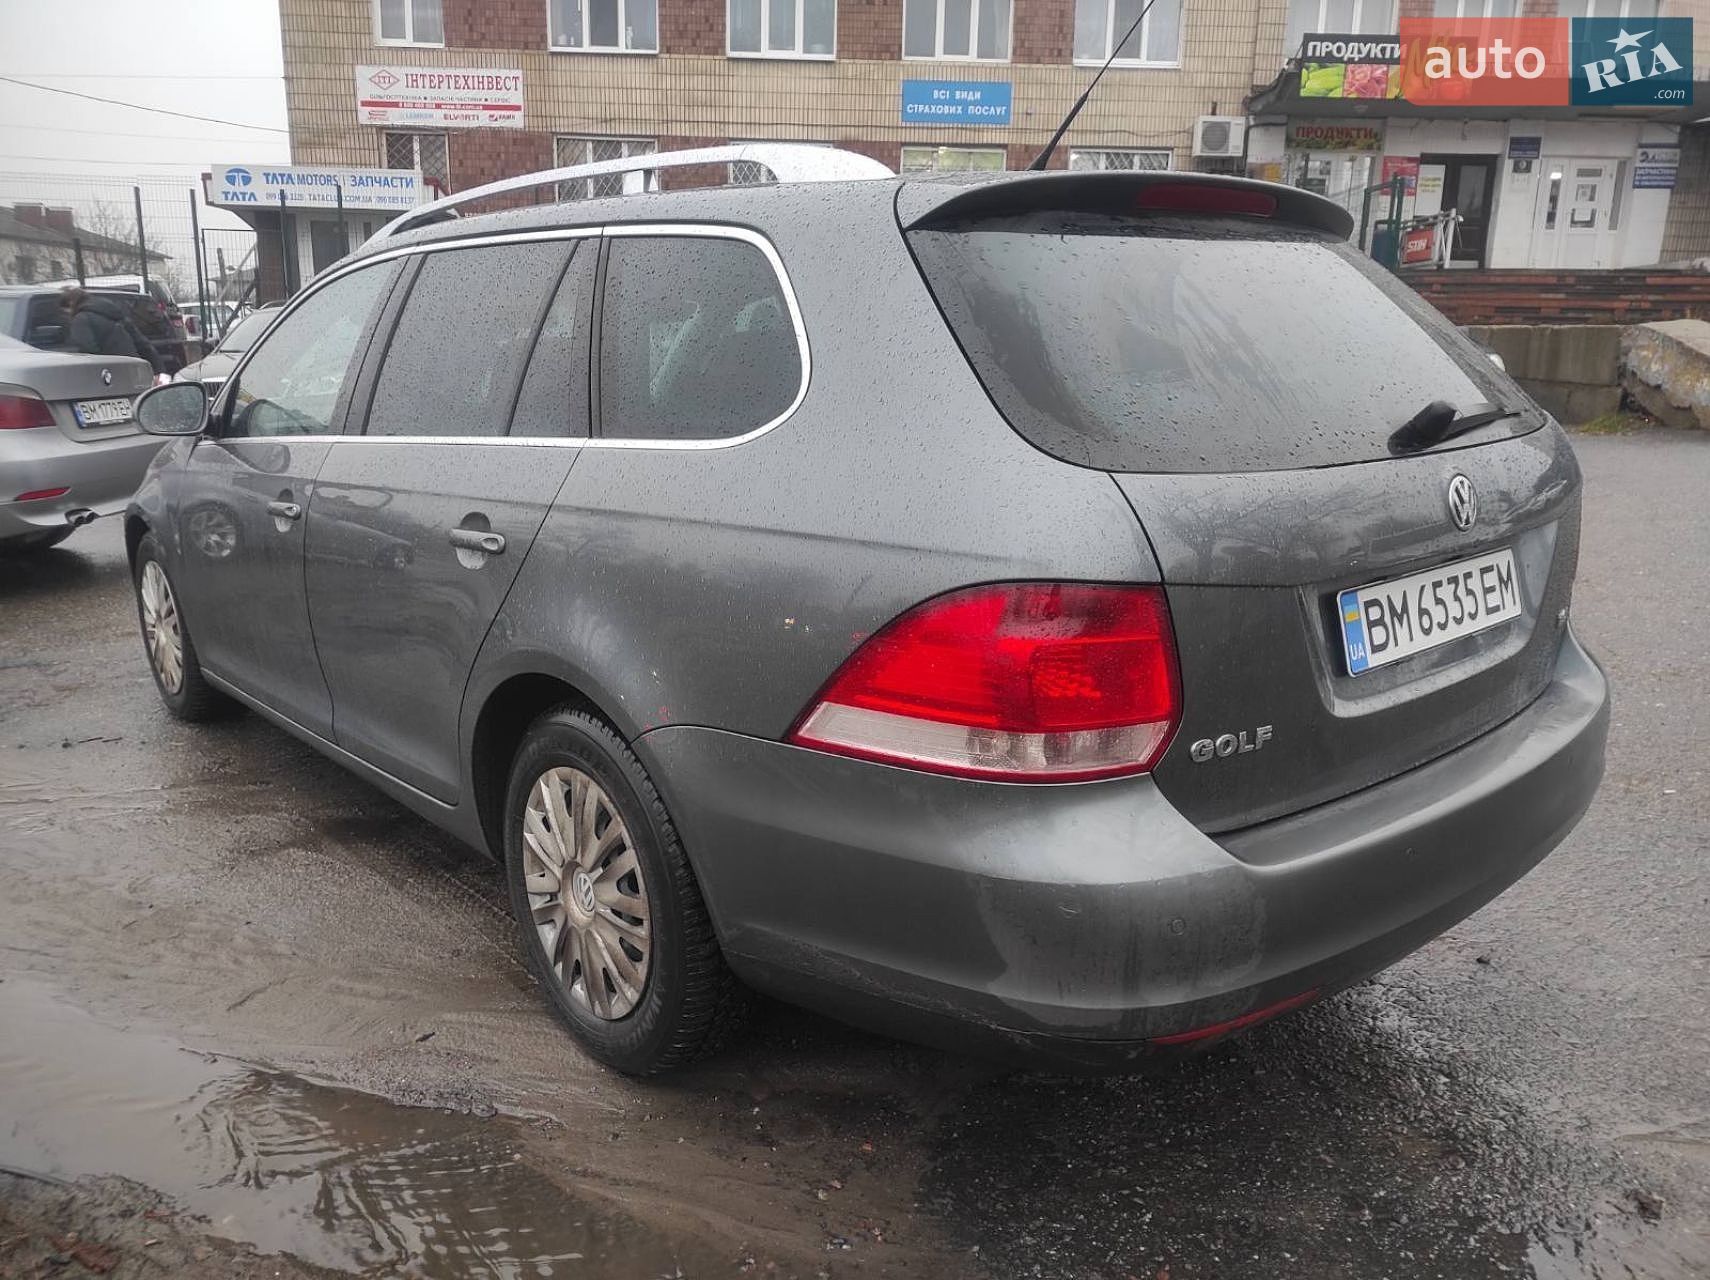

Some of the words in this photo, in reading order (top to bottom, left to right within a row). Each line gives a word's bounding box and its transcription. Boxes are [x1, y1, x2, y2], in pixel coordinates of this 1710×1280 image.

[1307, 41, 1408, 62] ПРОДУКТИ
[404, 73, 520, 91] ІНТЕРТЕХІНВЕСТ
[933, 89, 949, 100] ВСІ
[955, 90, 981, 101] ВИДИ
[907, 103, 963, 115] СТРАХОВИХ
[968, 105, 1008, 116] ПОСЛУГ
[1295, 126, 1375, 141] ПРОДУКТИ
[263, 172, 294, 185] TATA
[296, 173, 339, 187] MOTORS
[350, 174, 414, 188] ЗАПЧАСТИ
[221, 191, 257, 201] TATA
[1350, 642, 1365, 660] UA
[1189, 724, 1274, 763] GOLF
